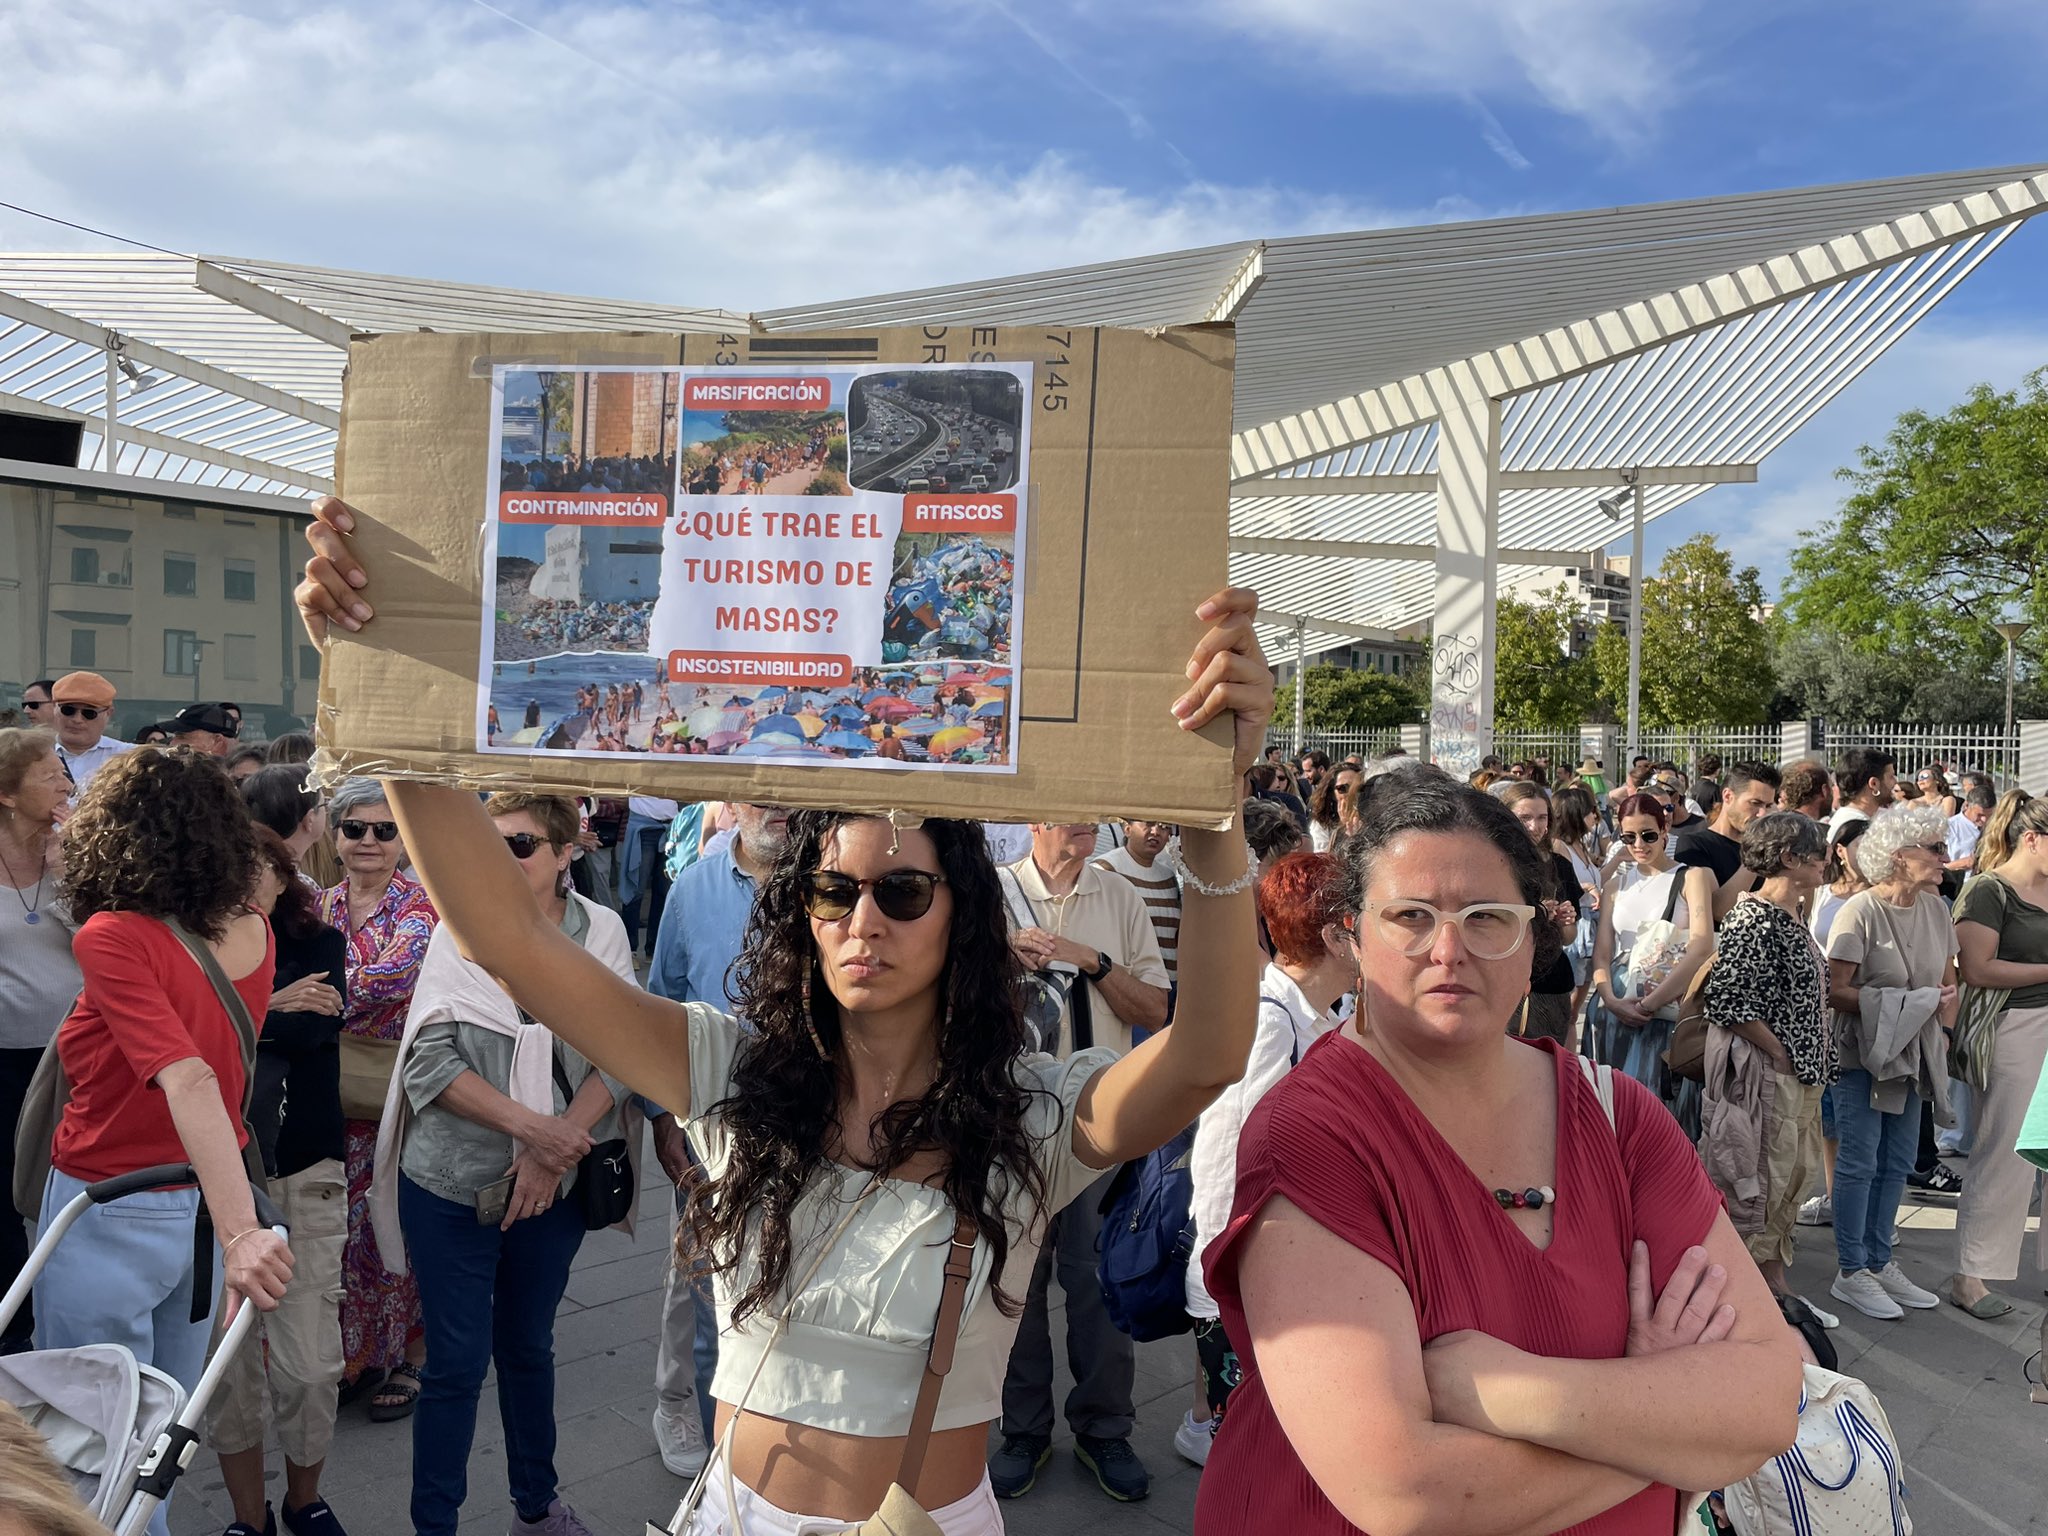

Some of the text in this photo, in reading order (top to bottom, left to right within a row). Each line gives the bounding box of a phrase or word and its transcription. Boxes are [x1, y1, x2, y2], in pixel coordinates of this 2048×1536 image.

[693, 380, 822, 400] MASIFICACIÓN
[507, 496, 658, 517] CONTAMINACIÓN
[916, 504, 1004, 520] ATASCOS
[675, 507, 883, 541] ¿QUÉ TRAE EL
[684, 558, 873, 586] TURISMO DE
[716, 606, 839, 634] MASAS?
[676, 658, 843, 677] INSOSTENIBILIDAD
